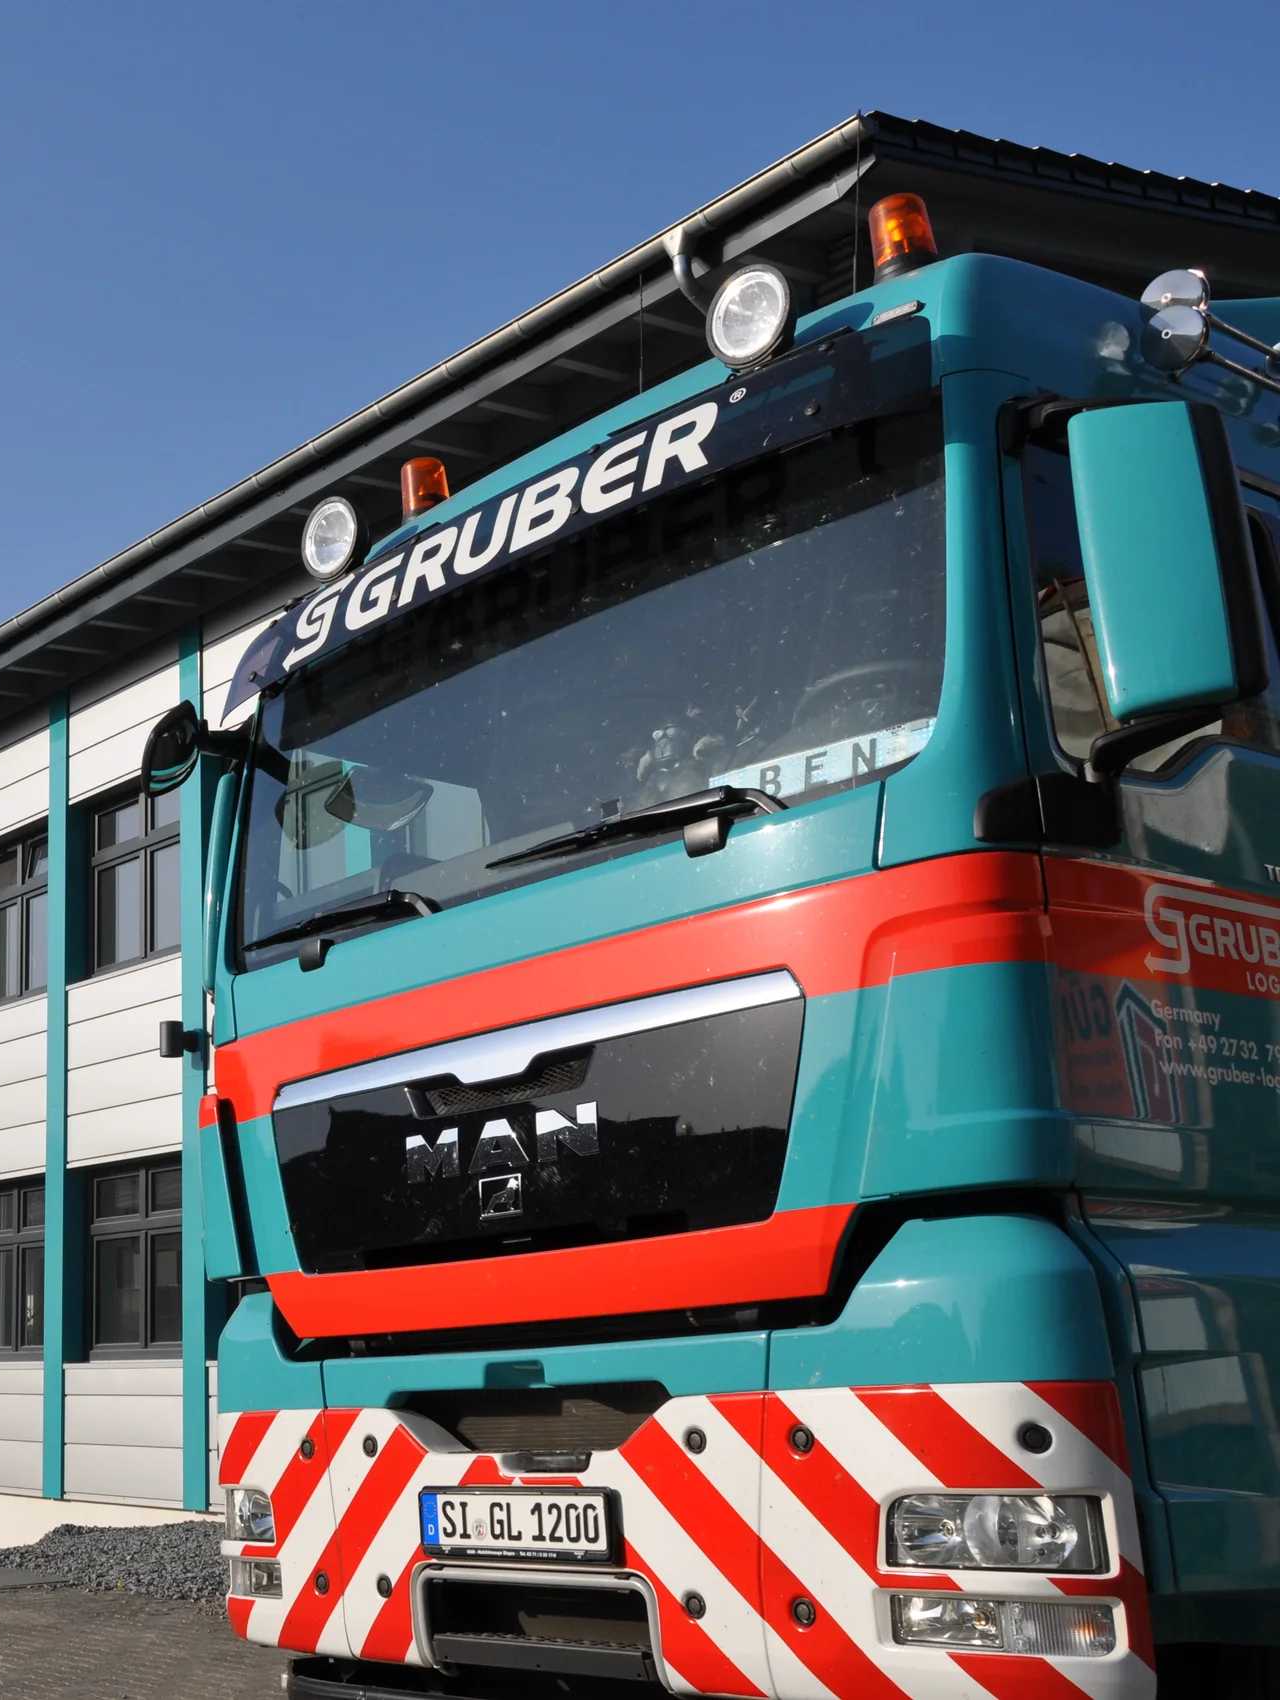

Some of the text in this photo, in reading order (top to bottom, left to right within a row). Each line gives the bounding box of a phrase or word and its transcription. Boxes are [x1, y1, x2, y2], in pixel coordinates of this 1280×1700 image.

[345, 402, 718, 631] GRUBER
[1150, 998, 1221, 1031] Germany
[1188, 1034, 1217, 1054] +49
[405, 1101, 600, 1184] MAN
[427, 1524, 435, 1536] D
[441, 1500, 600, 1544] SI GL 1200
